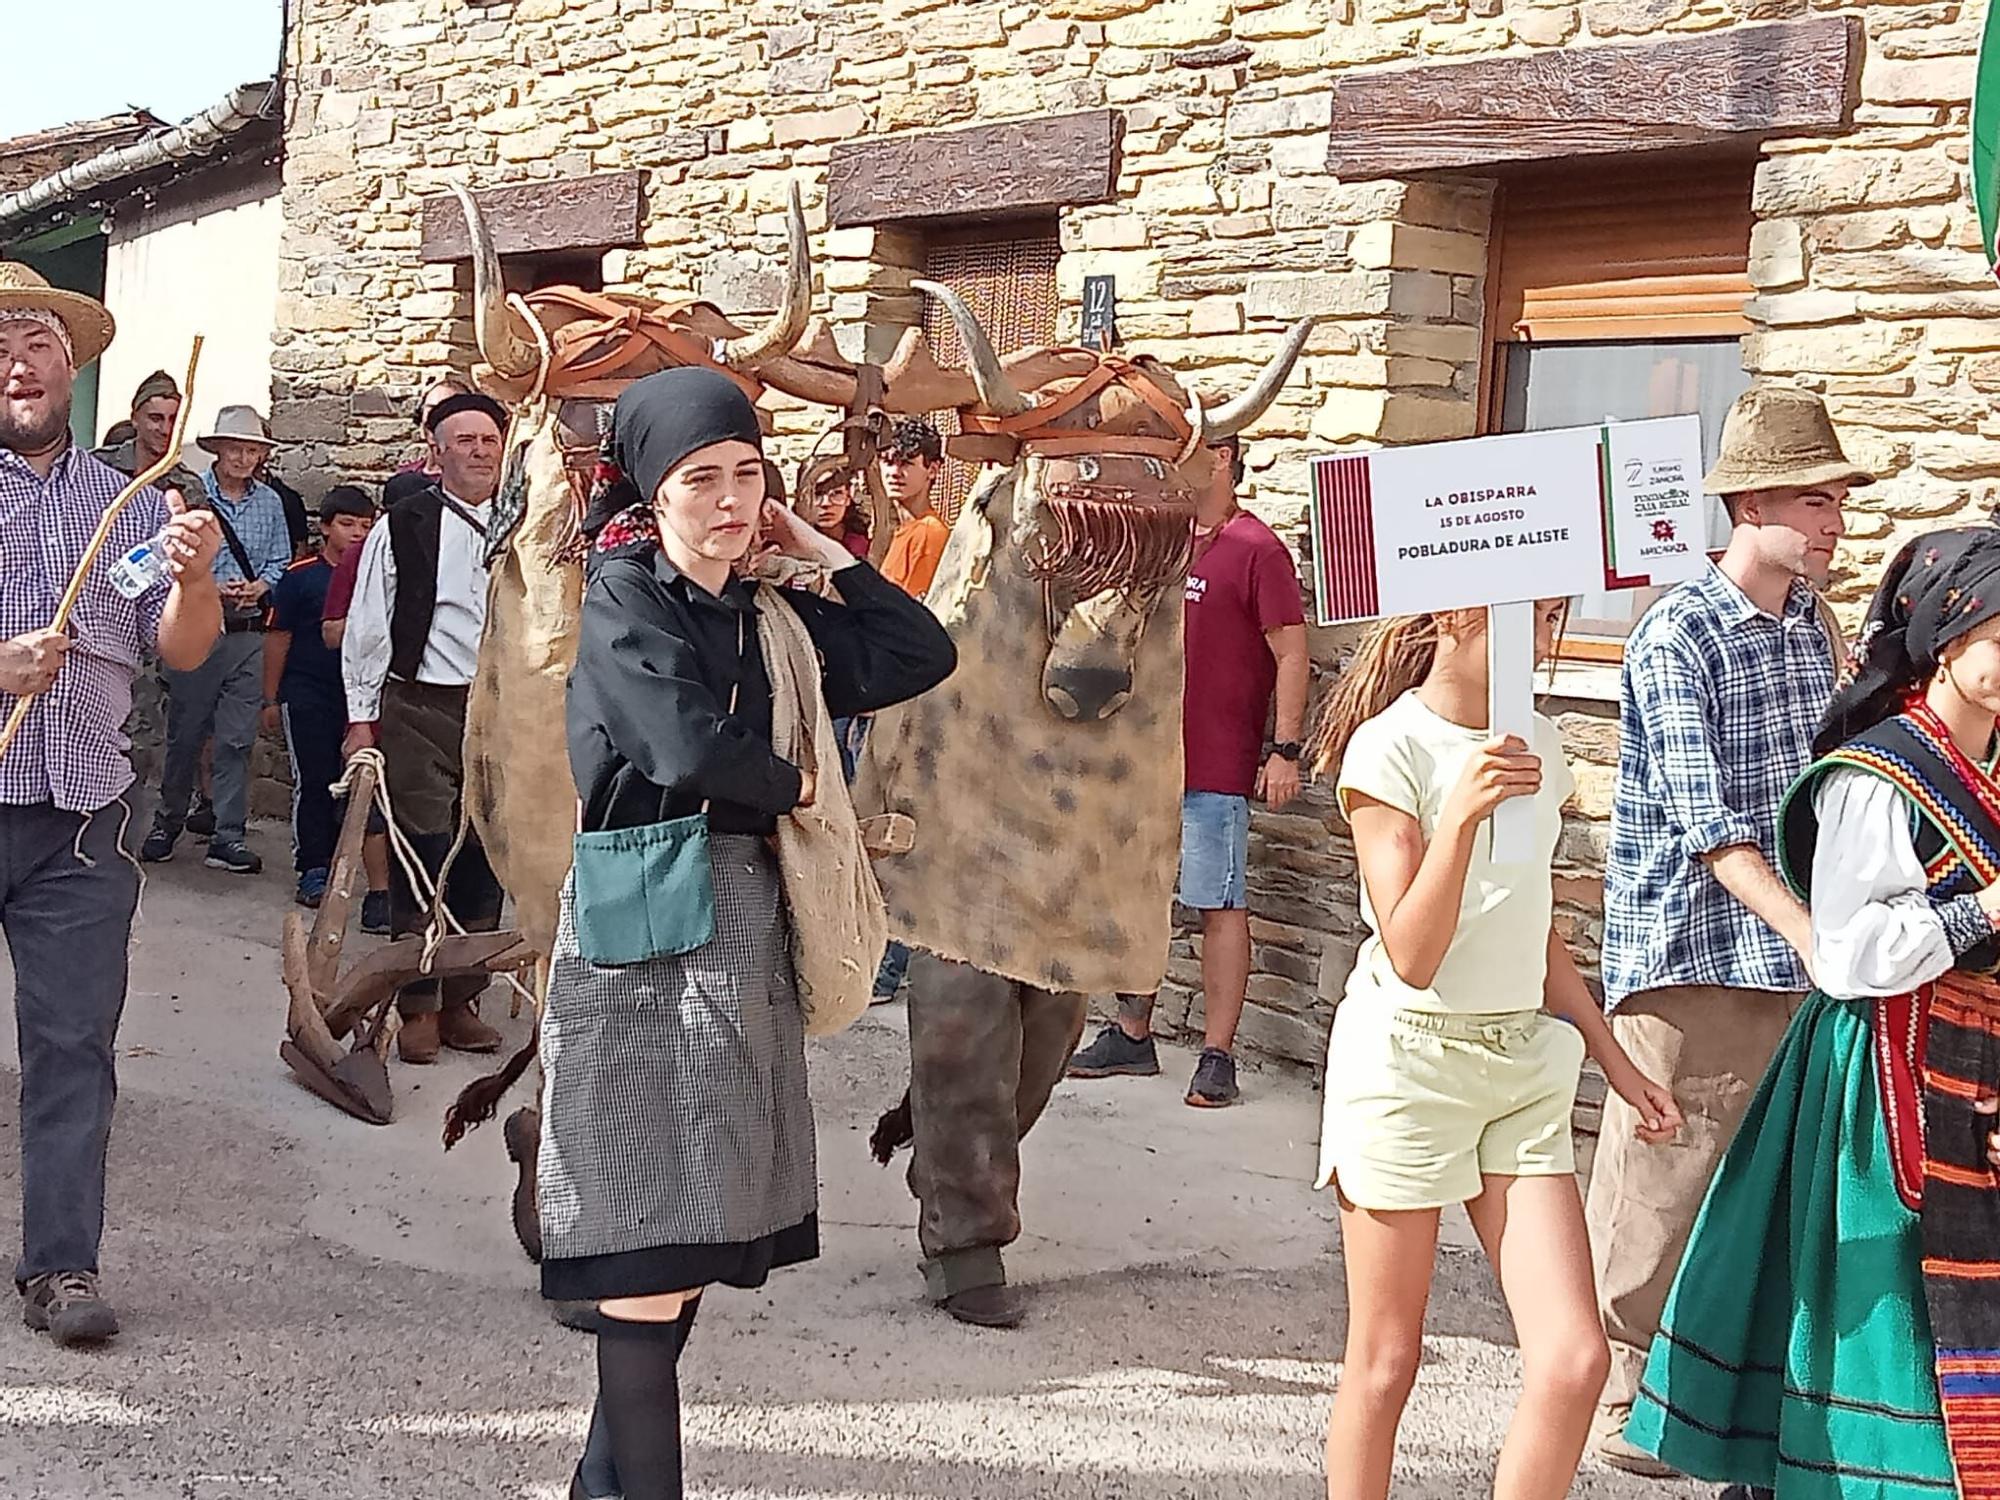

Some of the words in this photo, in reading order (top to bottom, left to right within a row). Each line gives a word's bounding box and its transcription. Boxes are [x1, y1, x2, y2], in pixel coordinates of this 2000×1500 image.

[1089, 281, 1106, 313] 12
[1425, 497, 1444, 508] LA
[1448, 485, 1537, 505] OBISPARRA
[1440, 516, 1453, 528] 15
[1456, 515, 1471, 527] DE
[1474, 509, 1525, 524] AGOSTO
[1398, 539, 1491, 560] POBLADURA
[1494, 534, 1514, 549] DE
[1517, 528, 1569, 547] ALISTE
